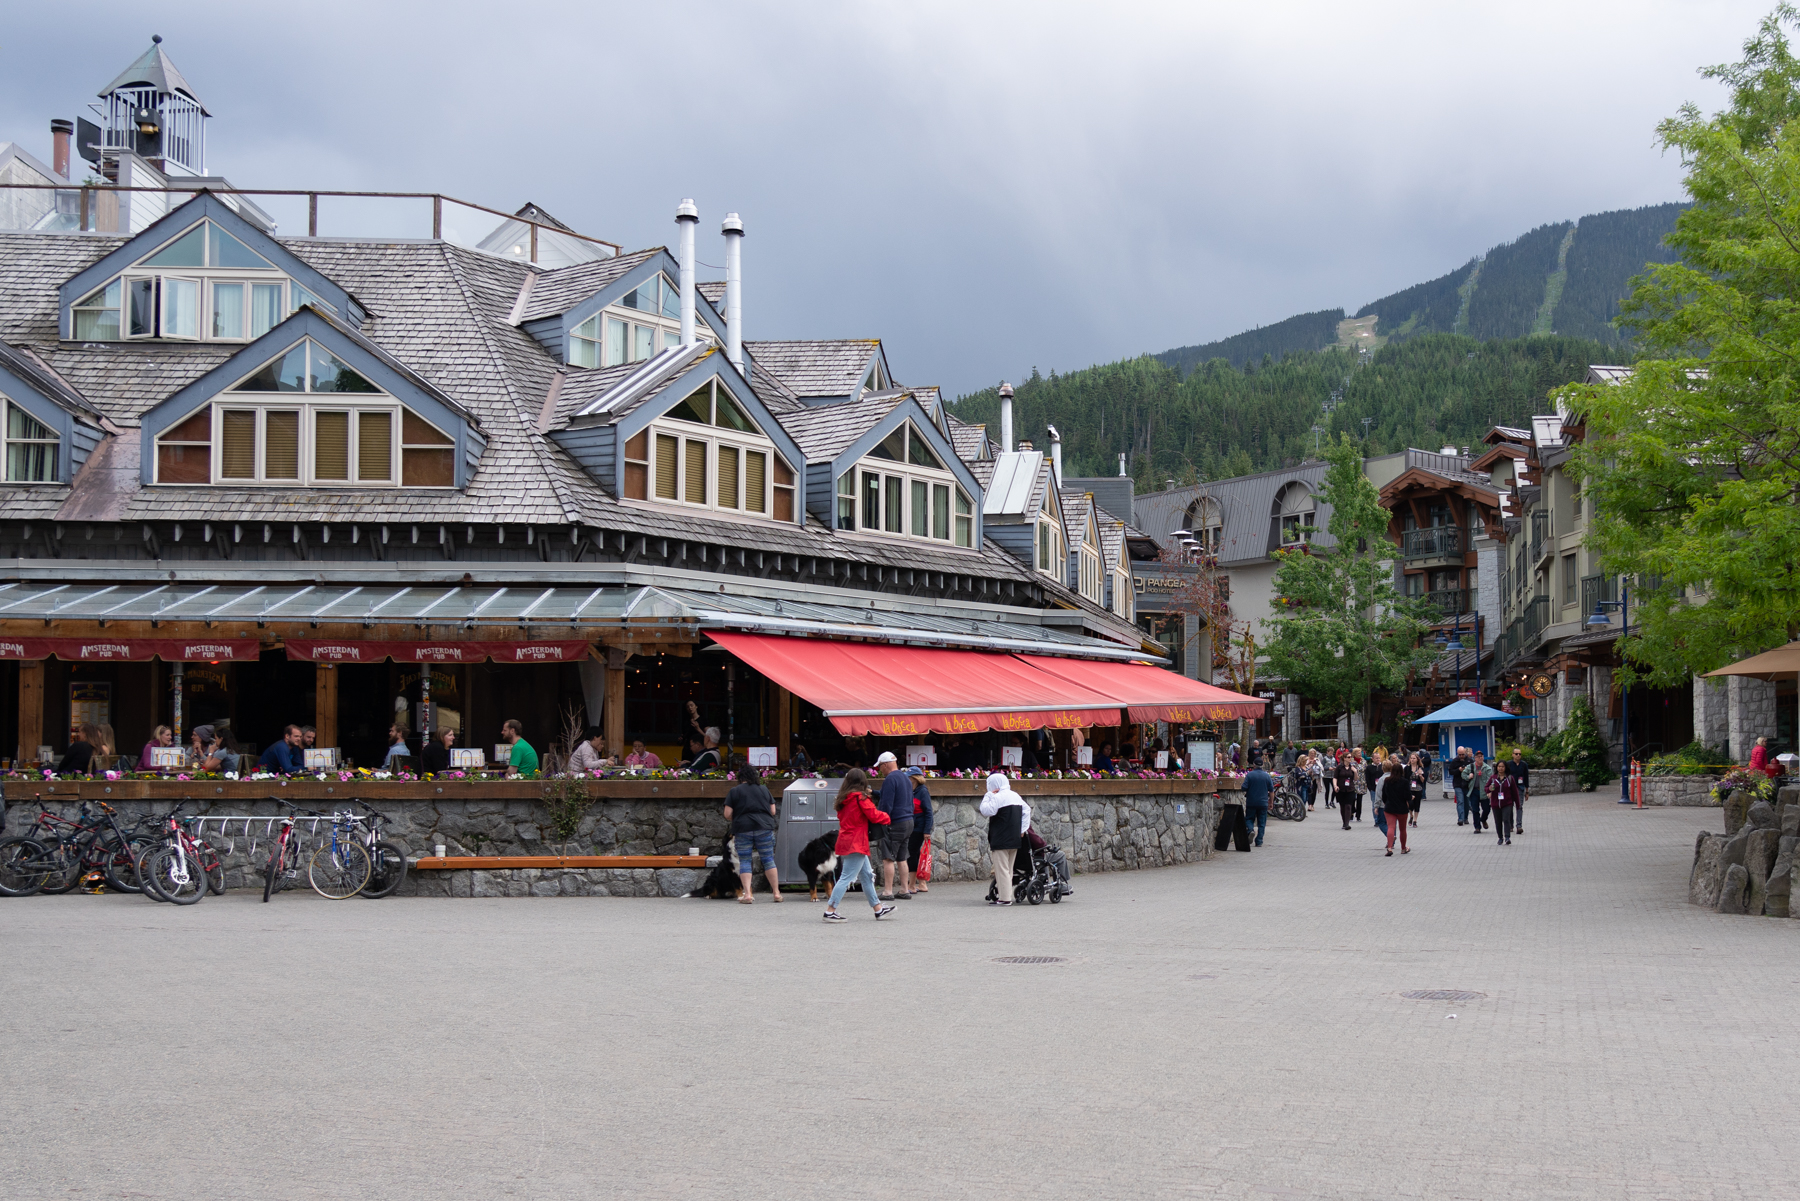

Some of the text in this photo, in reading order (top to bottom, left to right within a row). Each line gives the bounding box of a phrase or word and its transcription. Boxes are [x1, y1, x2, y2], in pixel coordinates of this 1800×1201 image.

[1147, 578, 1187, 587] PANGEA
[81, 644, 130, 658] AMSTERDAM
[185, 645, 234, 659] AMSTERDAM
[312, 646, 360, 660] AMSTERDAM
[416, 647, 462, 660] AMSTERDAM
[516, 646, 563, 660] AMSTERDAM
